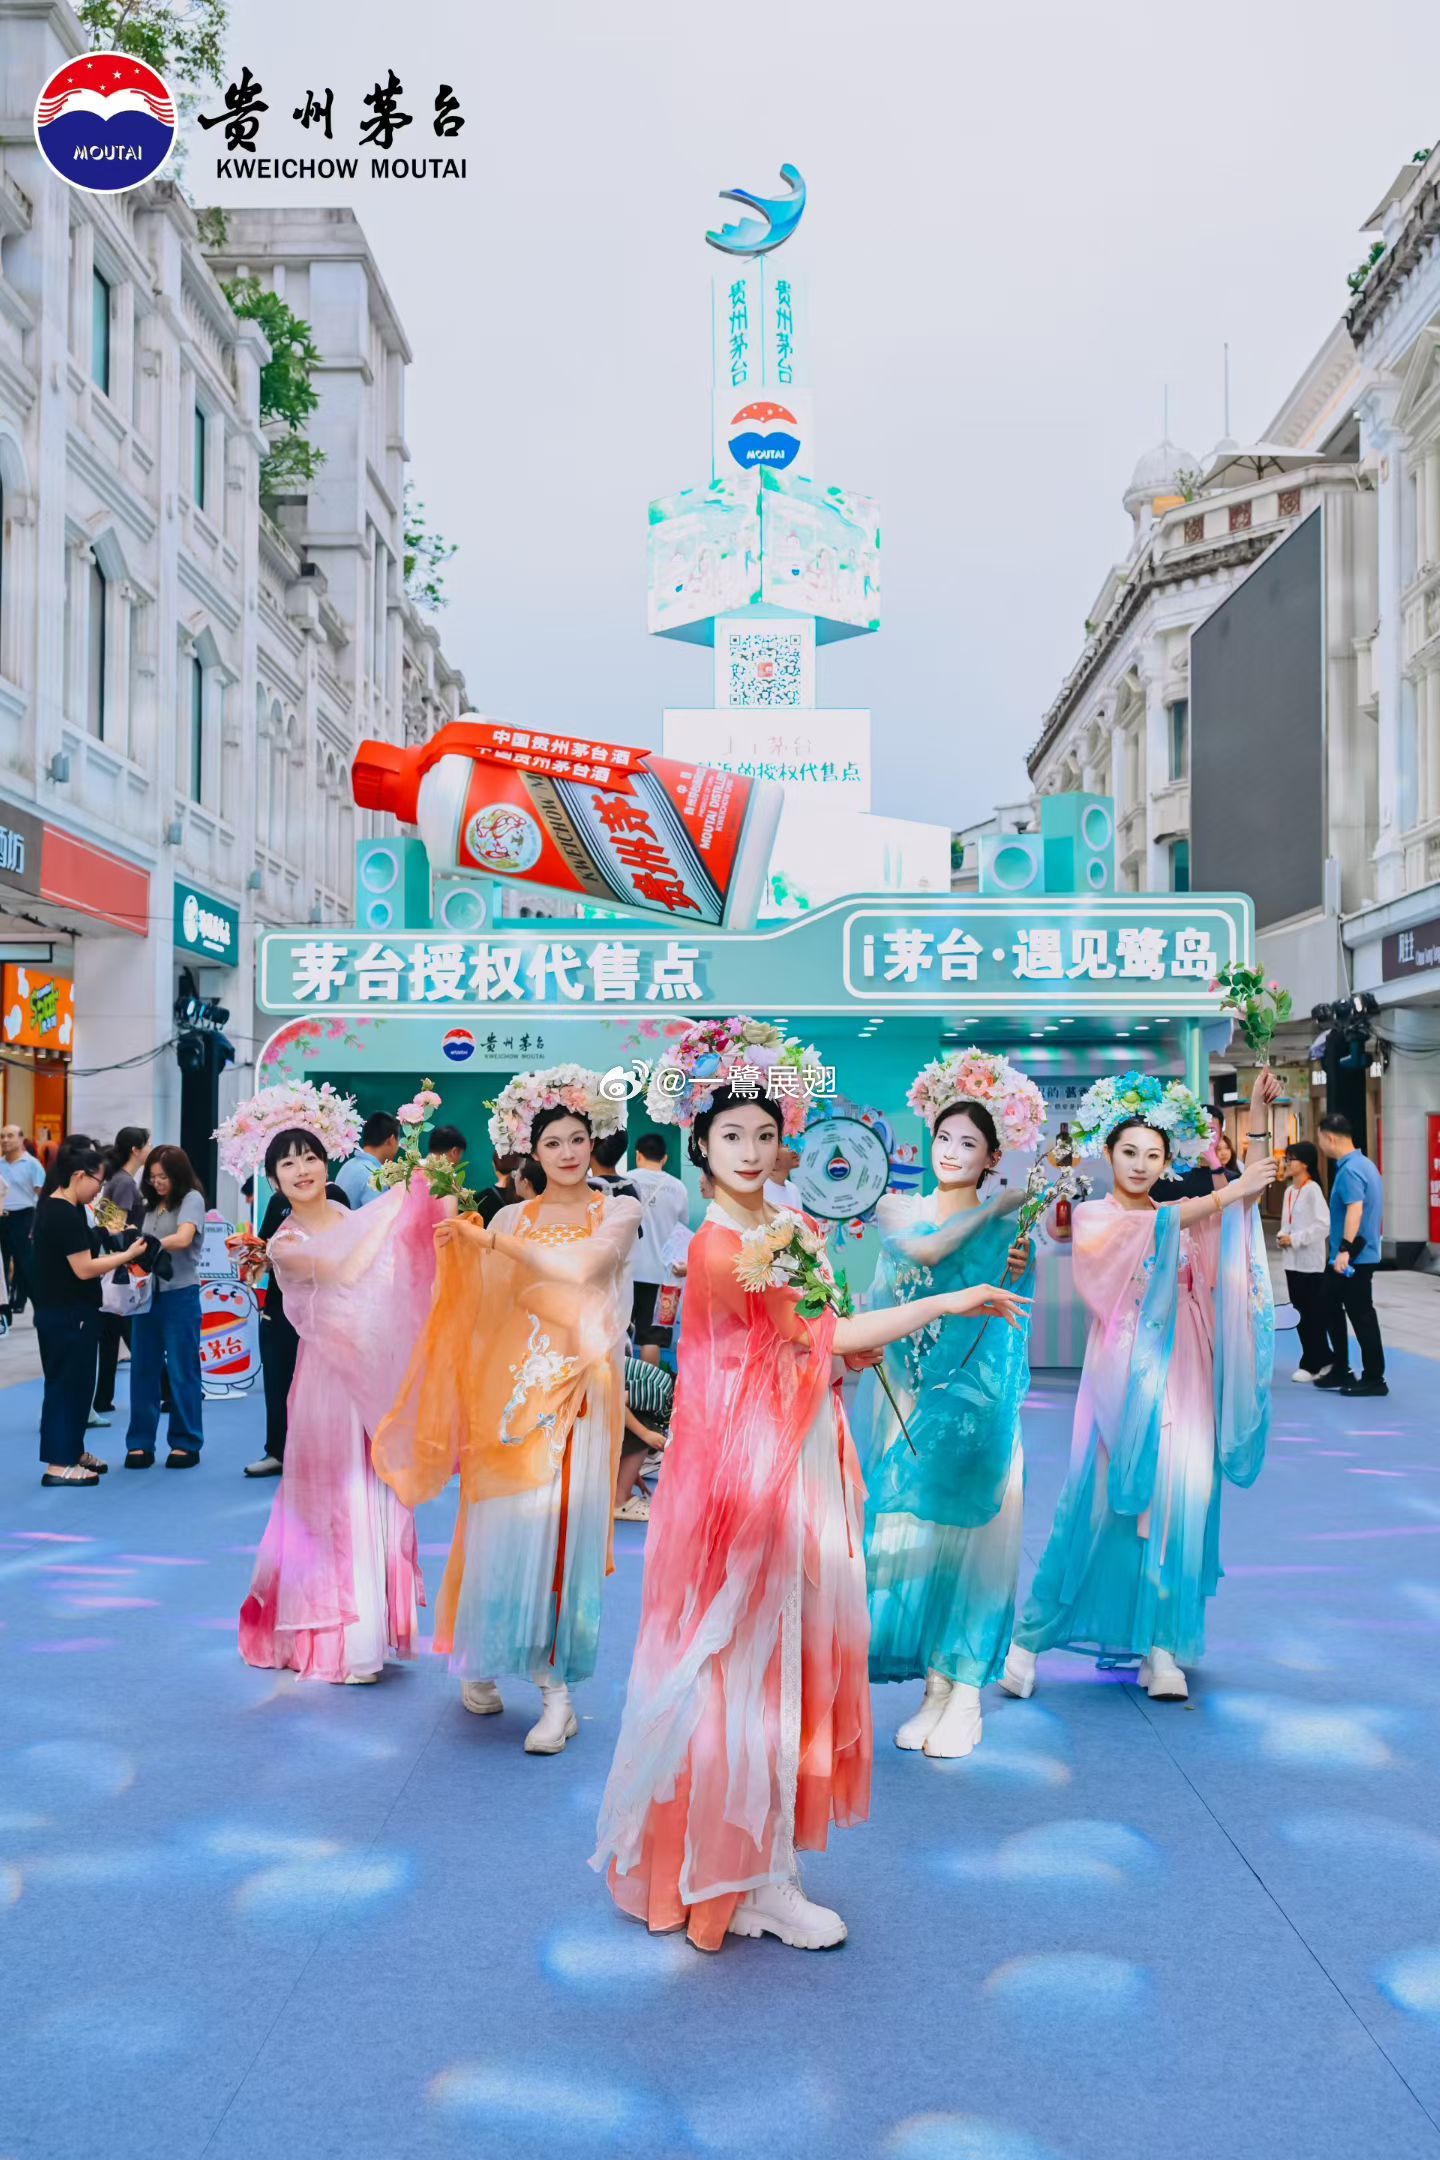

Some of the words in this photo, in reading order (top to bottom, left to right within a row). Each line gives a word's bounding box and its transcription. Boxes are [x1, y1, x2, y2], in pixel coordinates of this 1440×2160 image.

[746, 449, 785, 460] MOUTAI
[492, 729, 631, 766] 中国贵州茅台酒
[699, 810, 718, 850] MOUTAI
[290, 942, 703, 1001] 茅台授权代售点
[863, 927, 1217, 981] i茅台·遇见鹭岛
